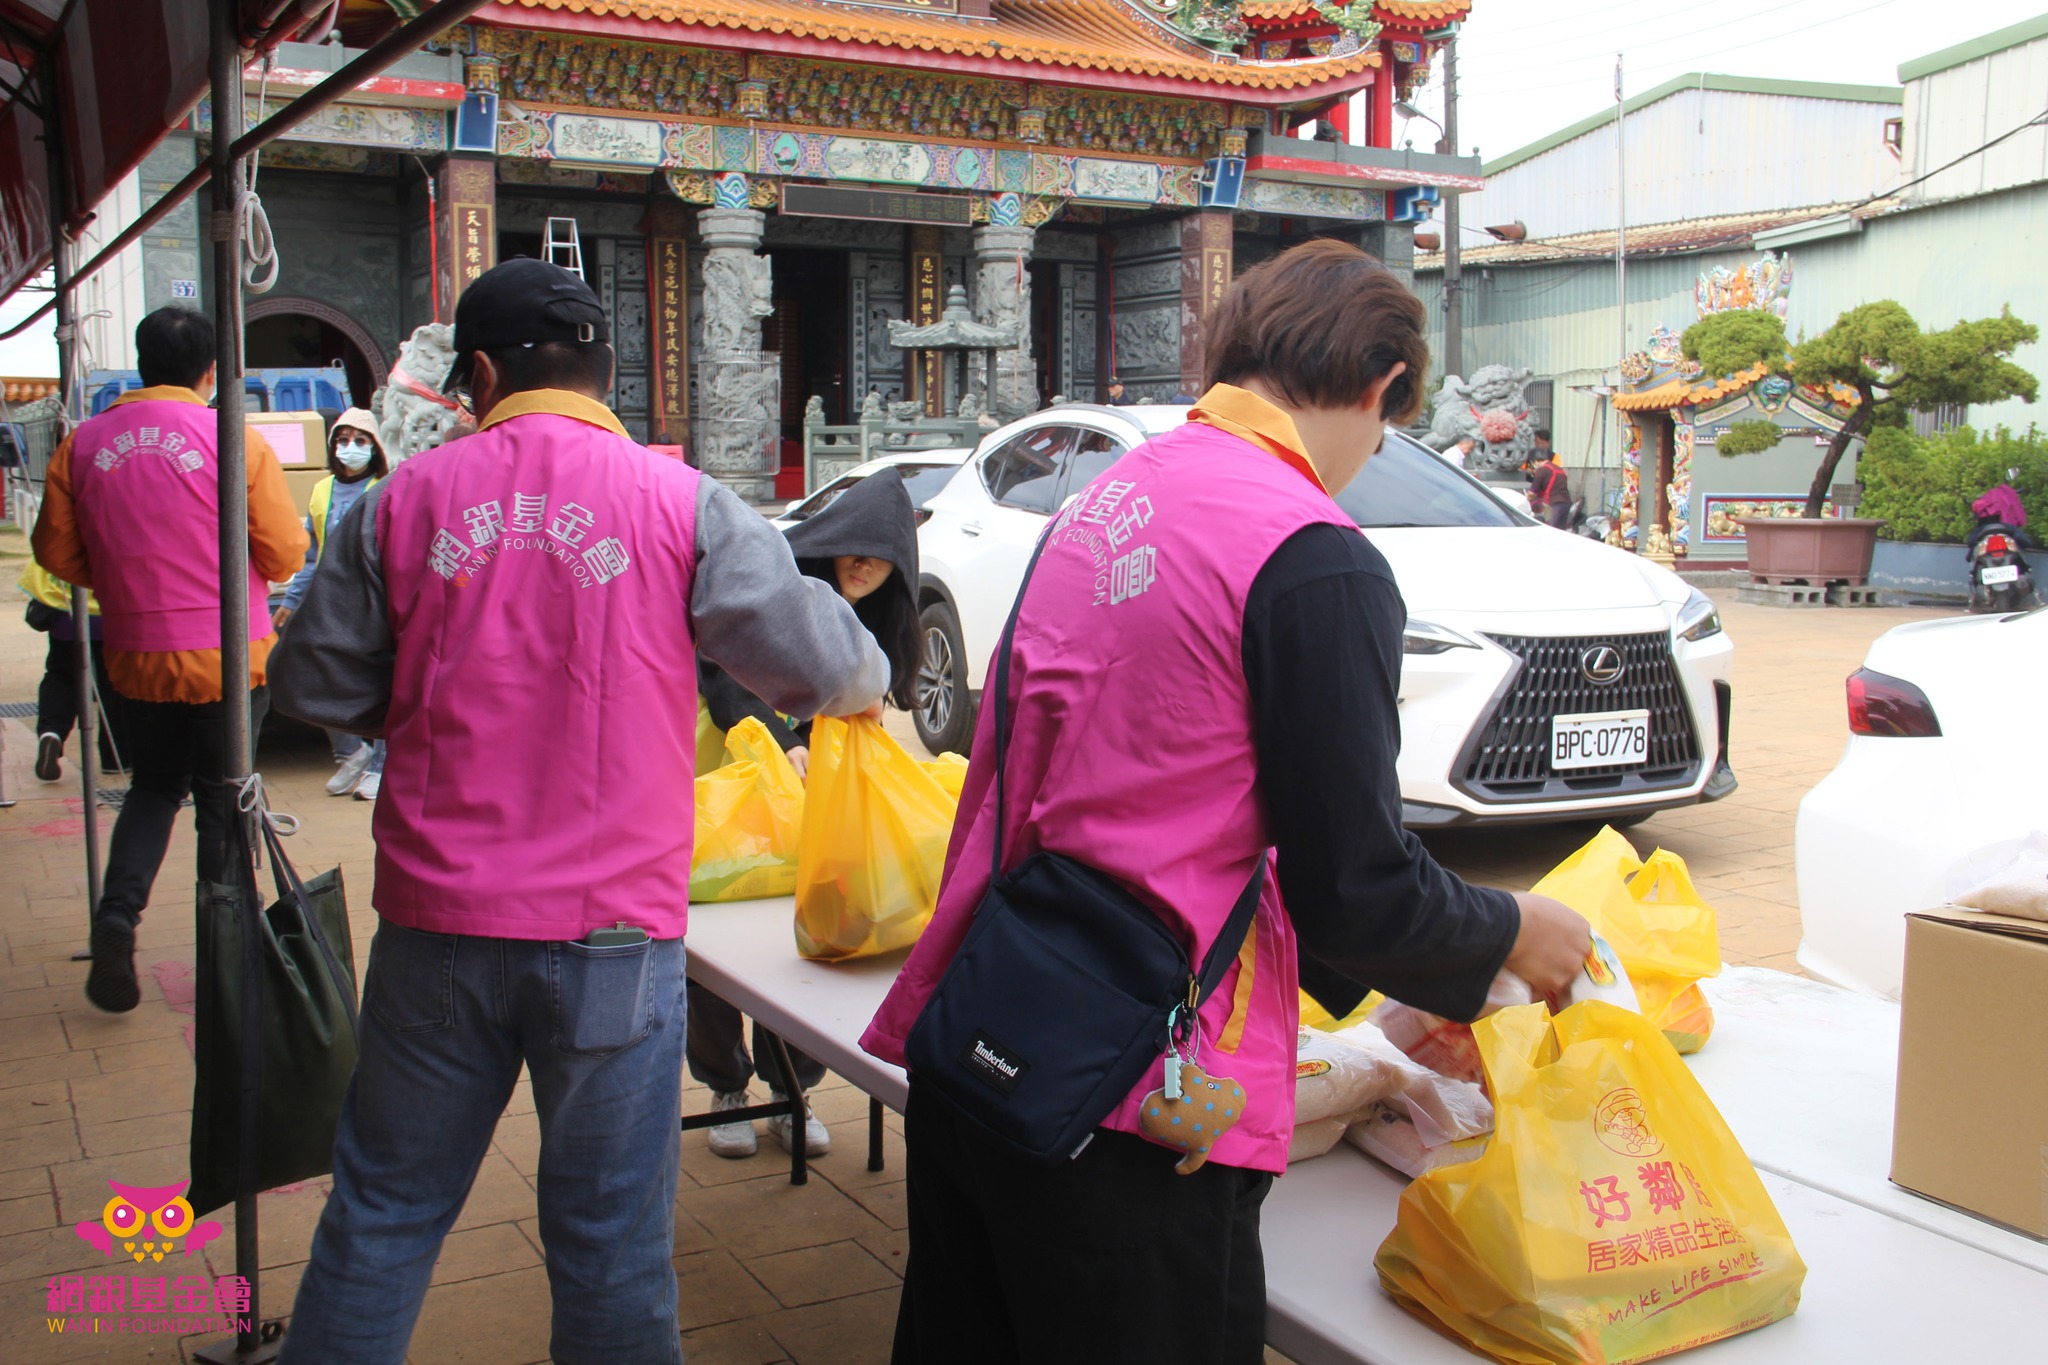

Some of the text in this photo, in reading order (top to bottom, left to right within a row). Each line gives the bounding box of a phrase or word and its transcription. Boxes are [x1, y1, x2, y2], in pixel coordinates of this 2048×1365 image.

[178, 286, 195, 296] 37
[94, 426, 205, 473] 網銀基金會
[427, 491, 631, 585] 網銀基金會
[453, 537, 594, 590] WANIN FOUNDATION
[1035, 480, 1157, 606] 銀基金會
[1063, 528, 1108, 606] FOUNDATION
[974, 1040, 1019, 1078] Timberland
[1608, 1251, 1765, 1325] MAKE LIFE SIMPLE
